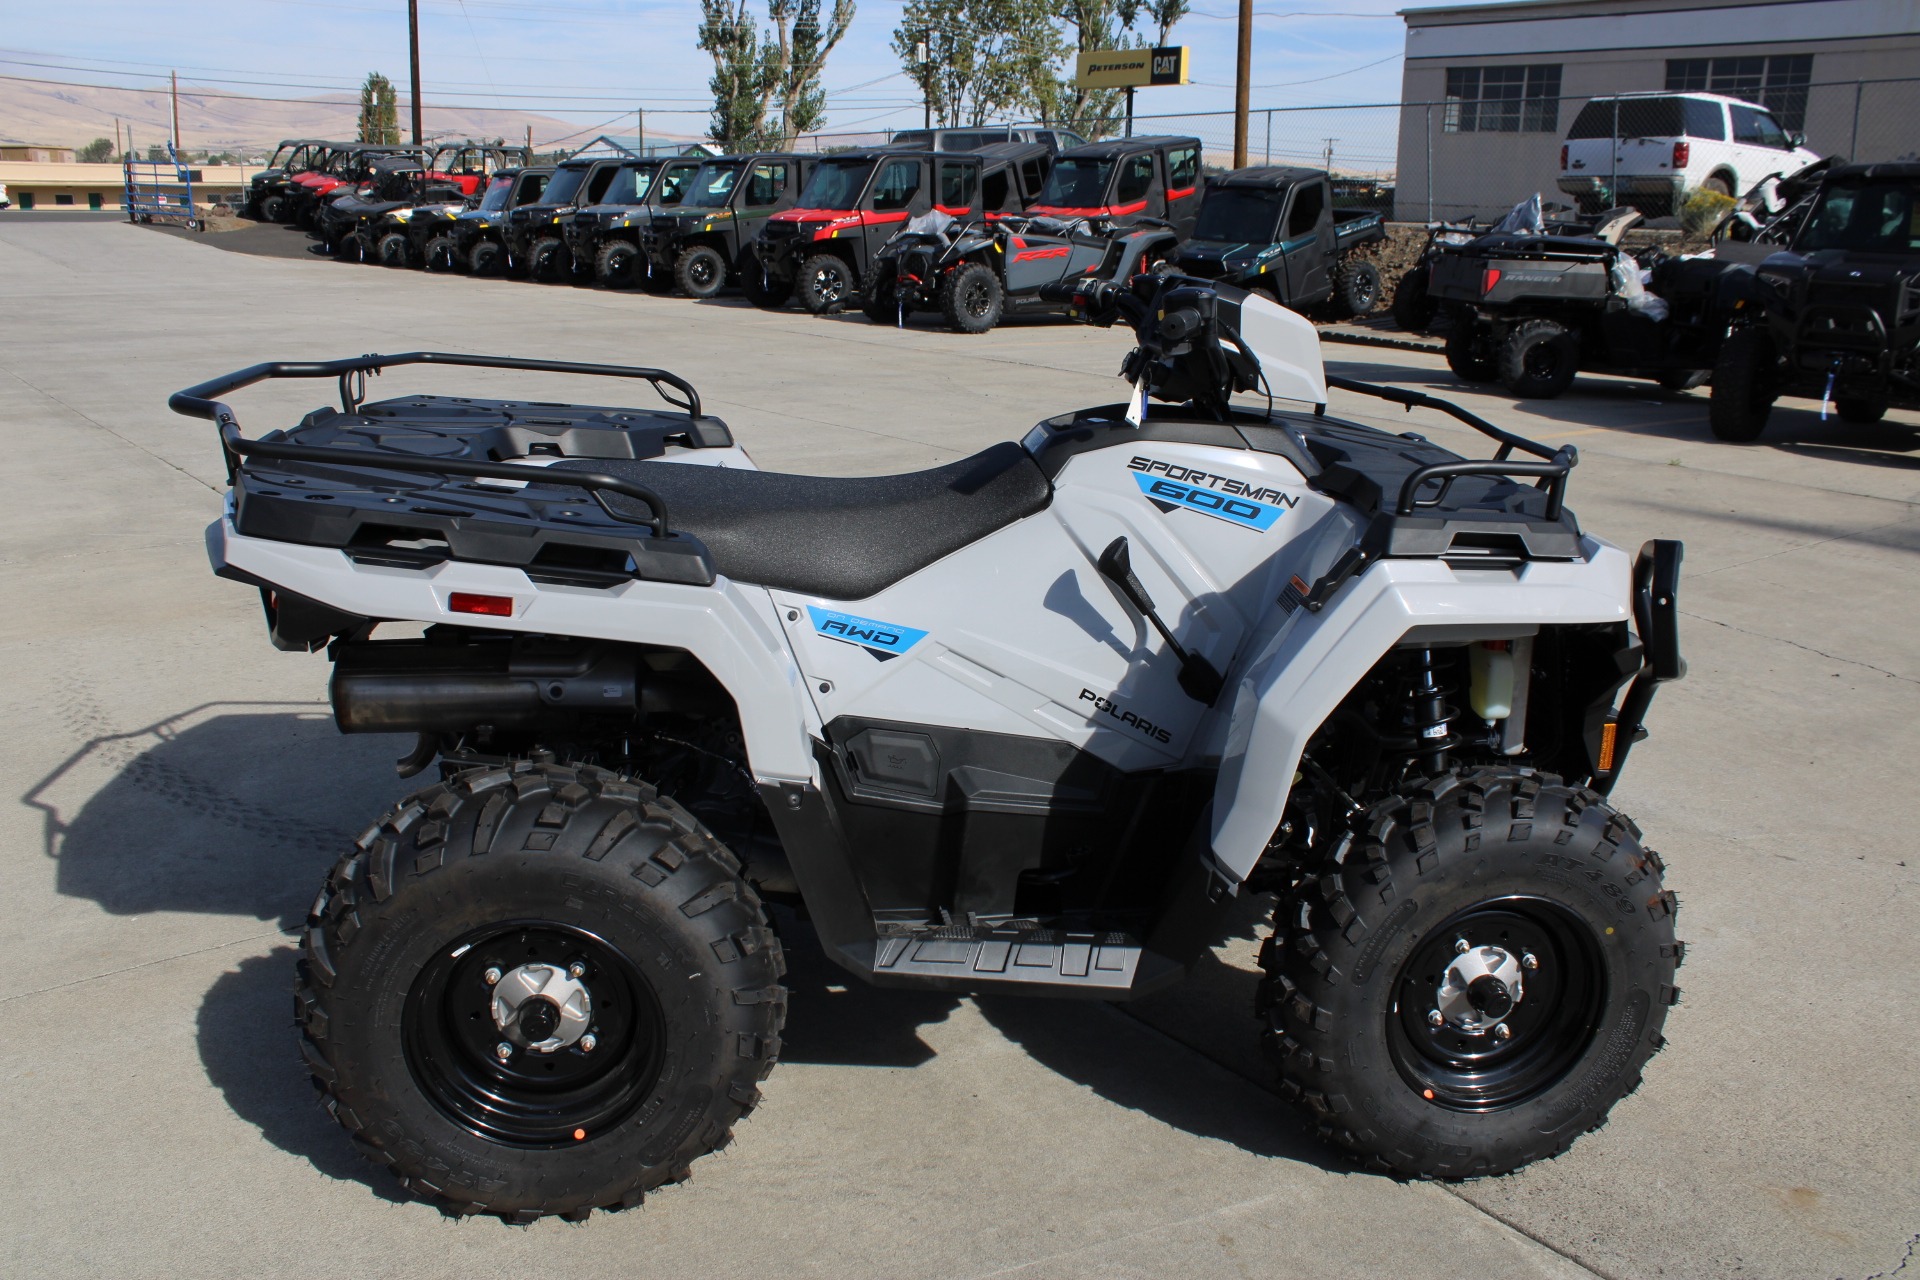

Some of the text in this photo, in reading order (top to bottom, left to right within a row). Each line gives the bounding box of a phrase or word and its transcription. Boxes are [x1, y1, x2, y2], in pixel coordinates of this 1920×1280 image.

[1087, 55, 1177, 76] PETERSON CAT
[1012, 247, 1070, 263] RZR
[1504, 274, 1562, 283] RANGER
[1127, 455, 1301, 509] SPORTSMAN
[1150, 480, 1262, 520] 600
[821, 619, 900, 646] AWD
[1078, 687, 1173, 744] POLARIS
